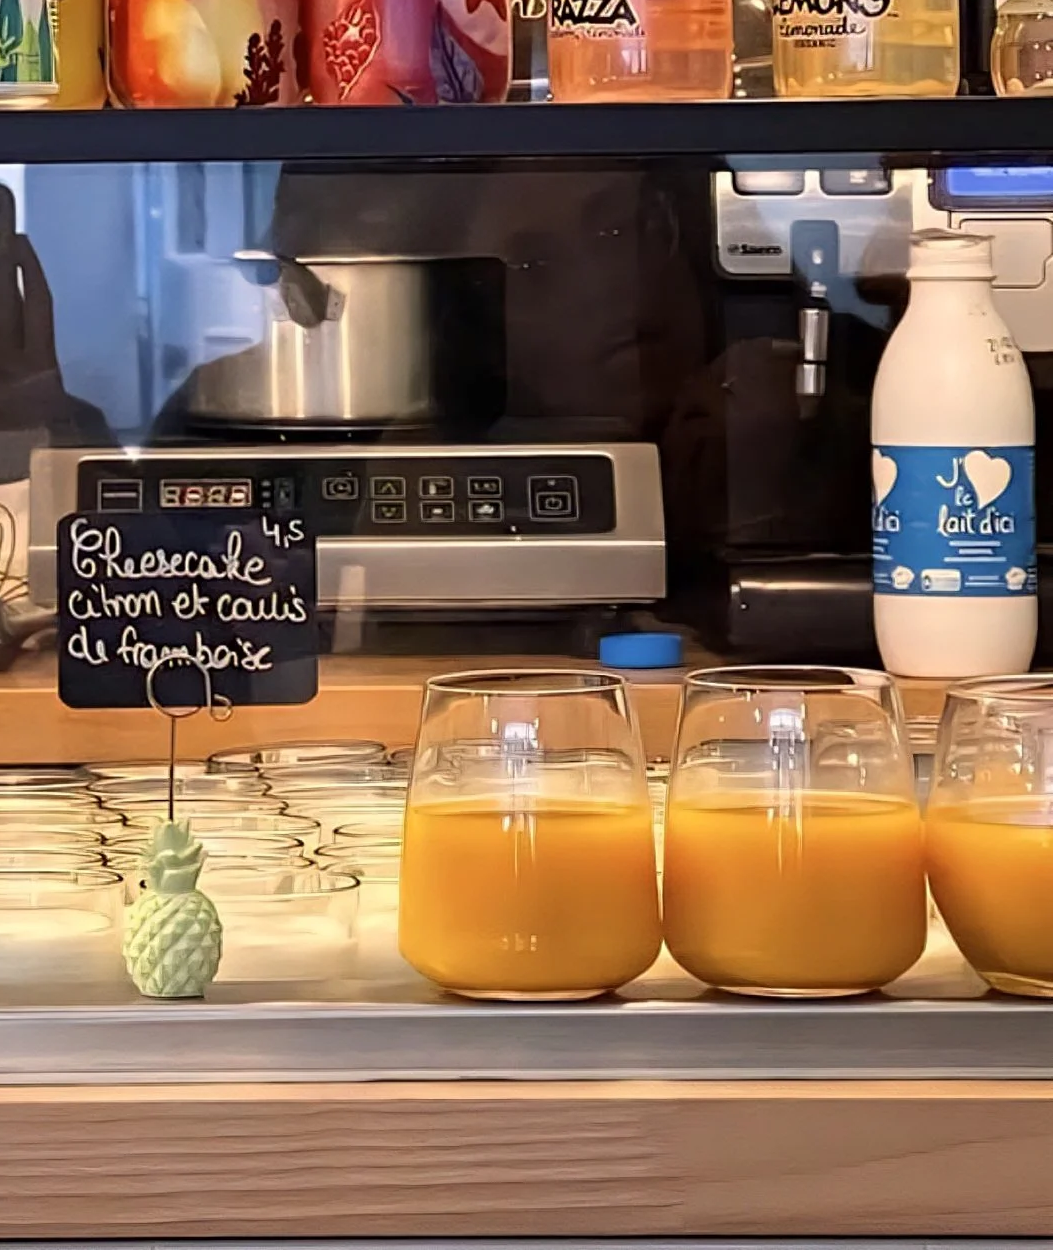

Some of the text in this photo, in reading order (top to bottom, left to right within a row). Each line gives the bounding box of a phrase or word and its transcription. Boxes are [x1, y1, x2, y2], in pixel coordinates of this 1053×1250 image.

[262, 516, 304, 548] 4,5
[936, 503, 976, 537] lait
[70, 518, 272, 585] Cheesecake
[68, 584, 162, 620] citron
[171, 583, 210, 620] et
[68, 625, 273, 671] de framboise
